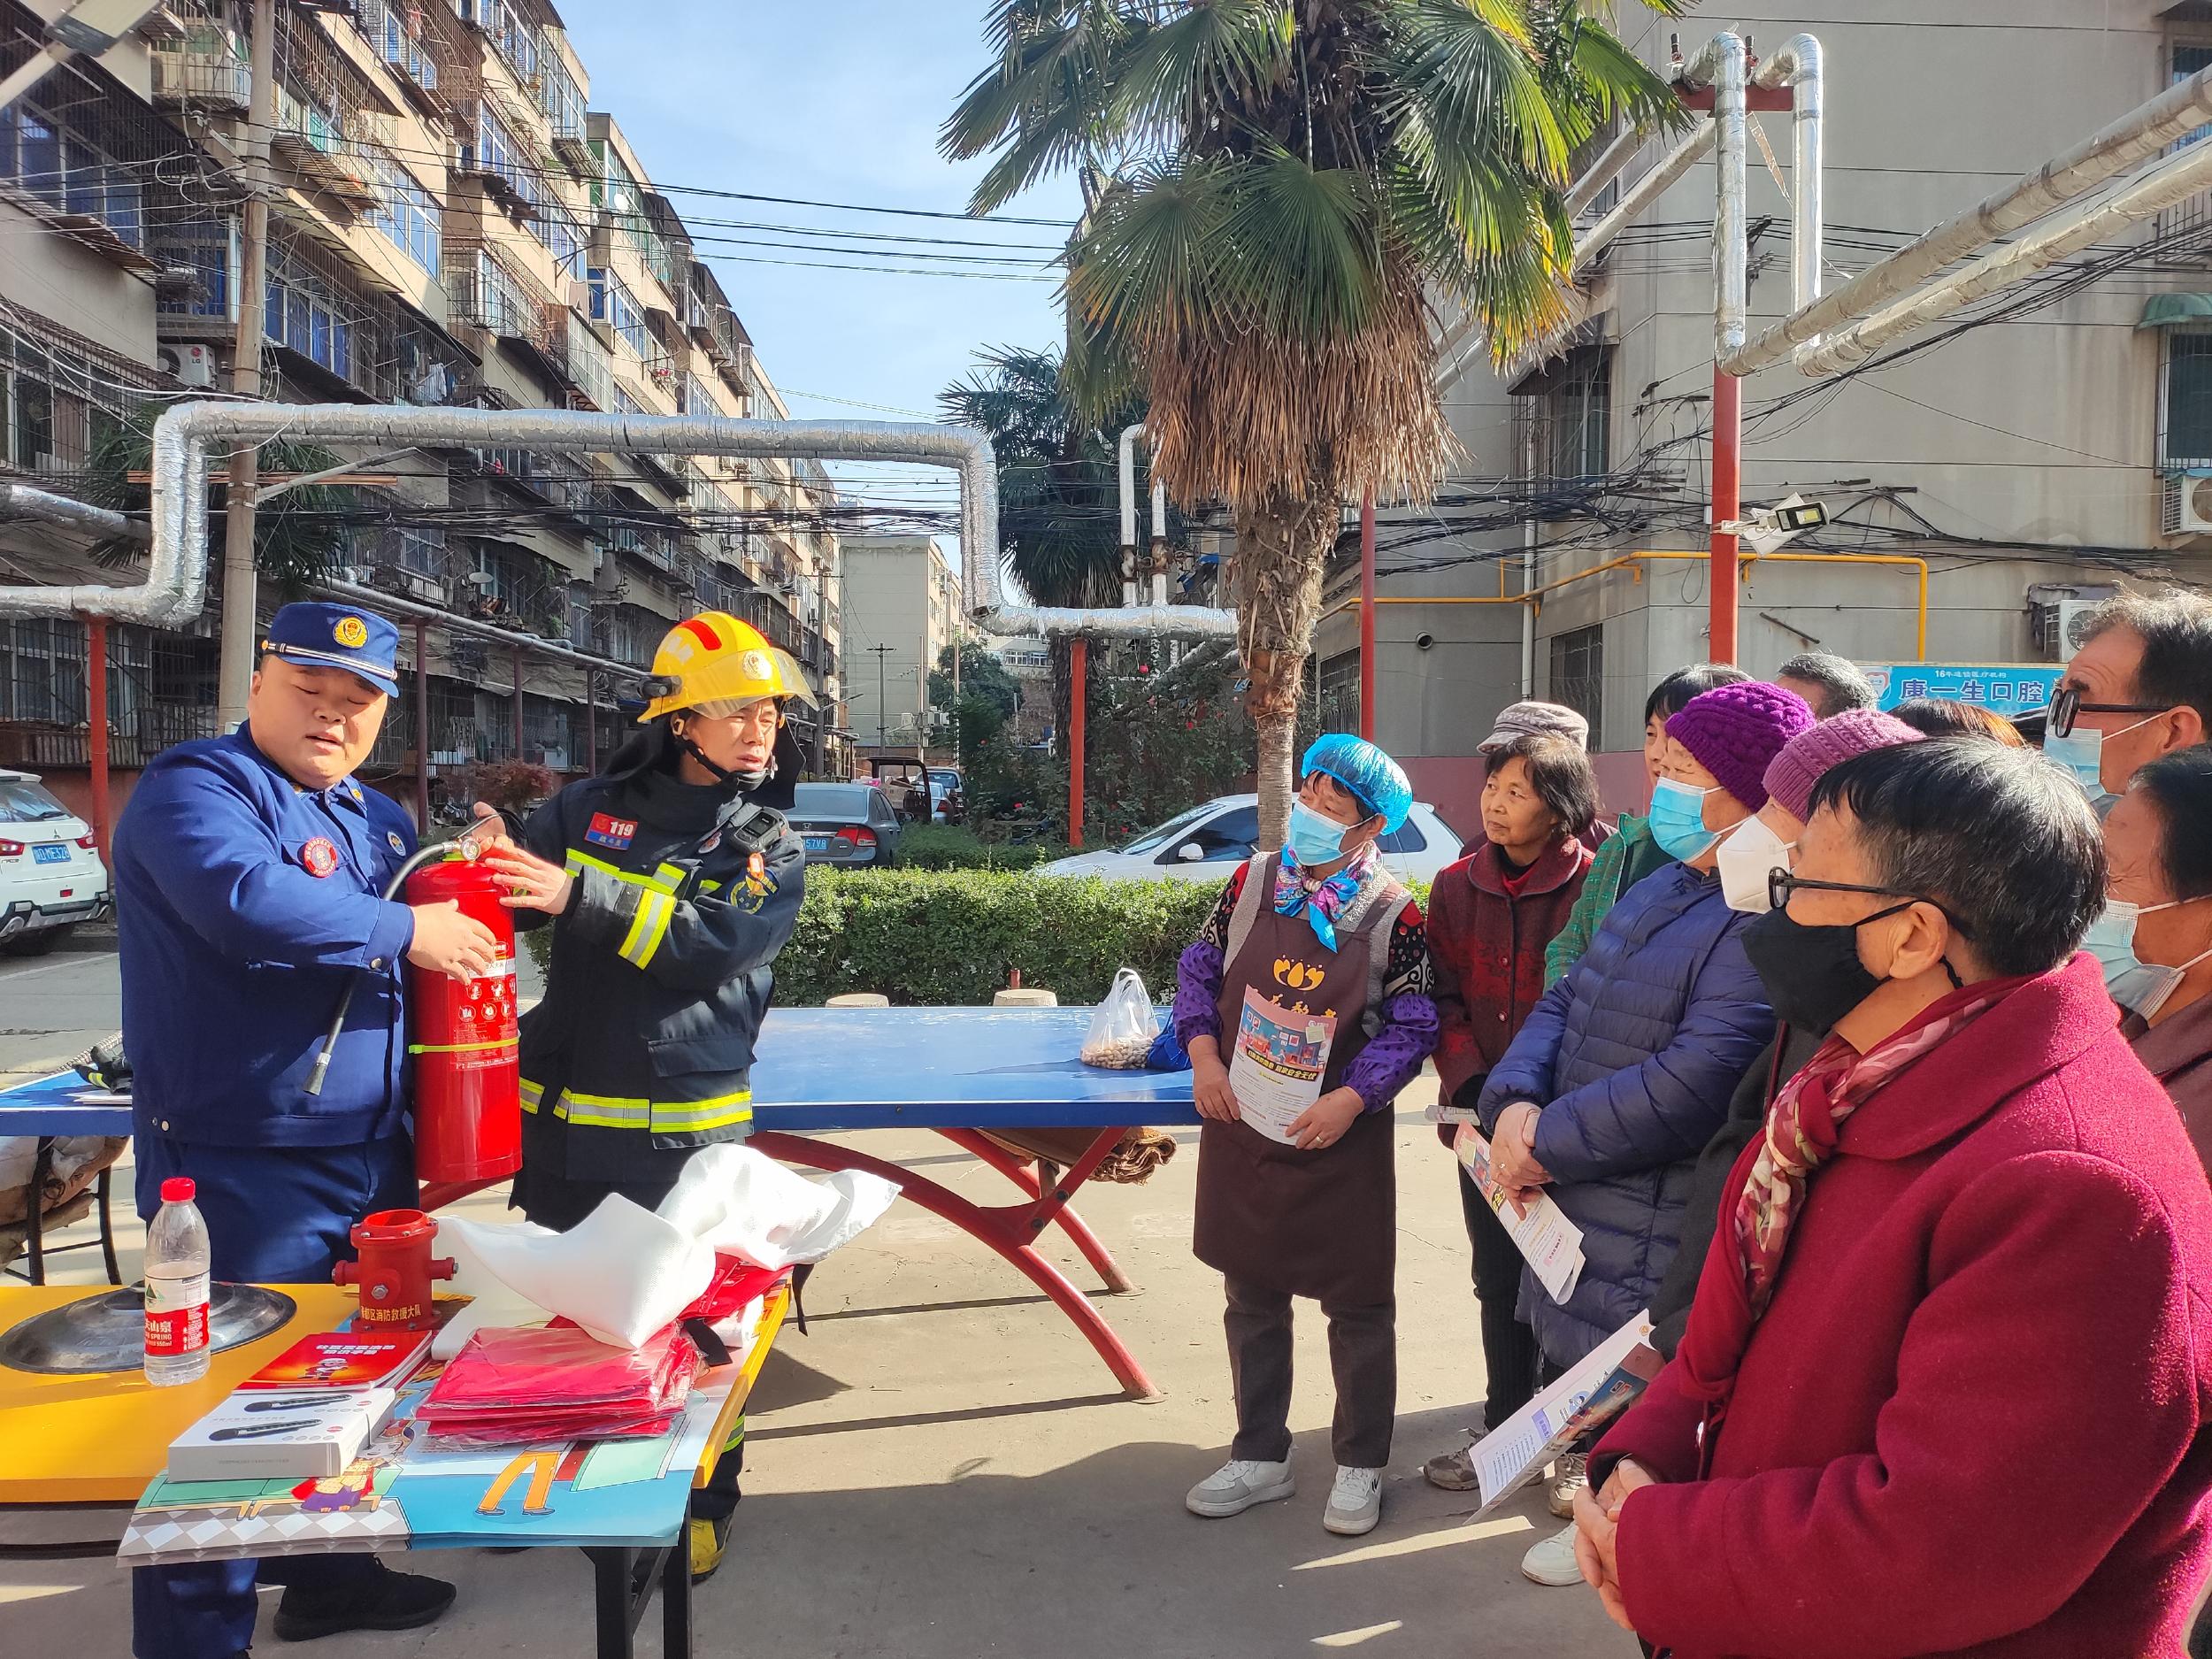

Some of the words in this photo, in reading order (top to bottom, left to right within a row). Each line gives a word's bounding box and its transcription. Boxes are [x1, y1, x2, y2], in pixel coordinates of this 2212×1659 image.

[1900, 678, 2044, 703] 康一生口腔
[610, 821, 634, 836] 119
[803, 838, 826, 848] 57V8
